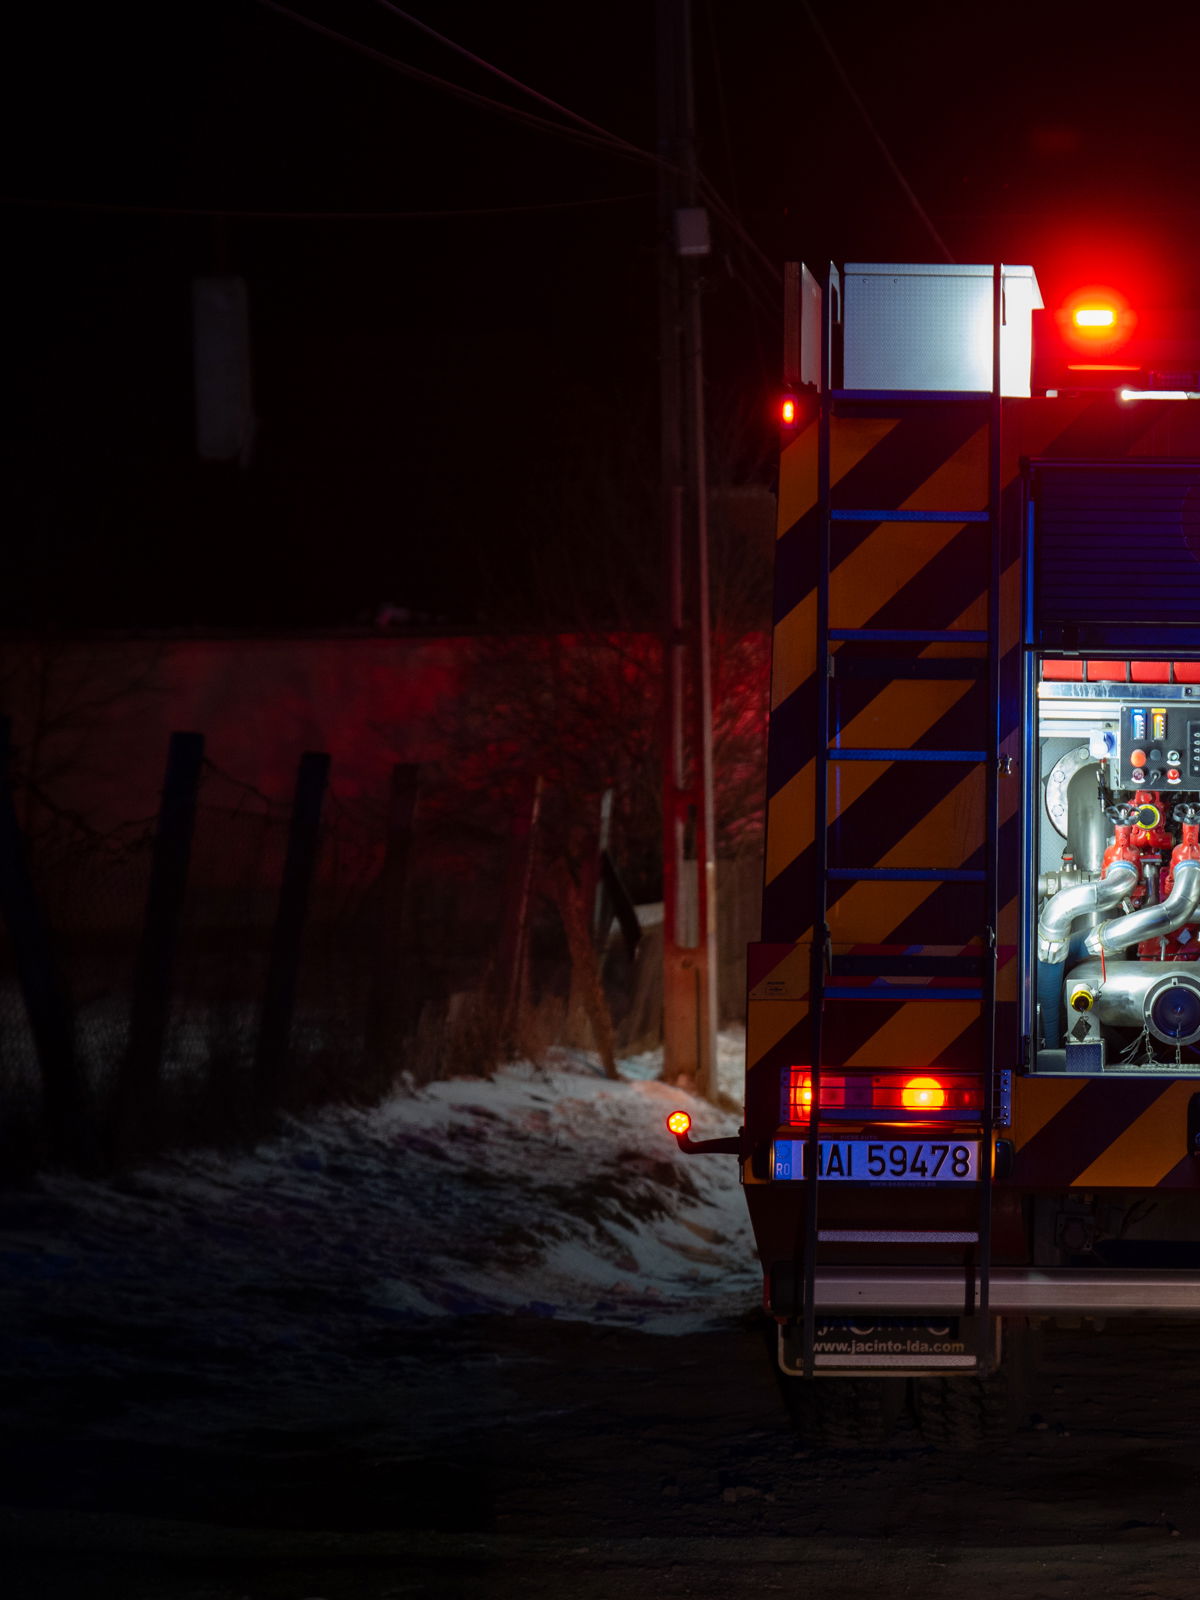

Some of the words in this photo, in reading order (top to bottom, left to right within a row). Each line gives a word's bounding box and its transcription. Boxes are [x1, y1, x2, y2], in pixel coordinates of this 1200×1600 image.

[868, 1145, 971, 1177] 59478
[776, 1162, 790, 1176] RO
[812, 1339, 965, 1354] www.jacinto-lda.com
